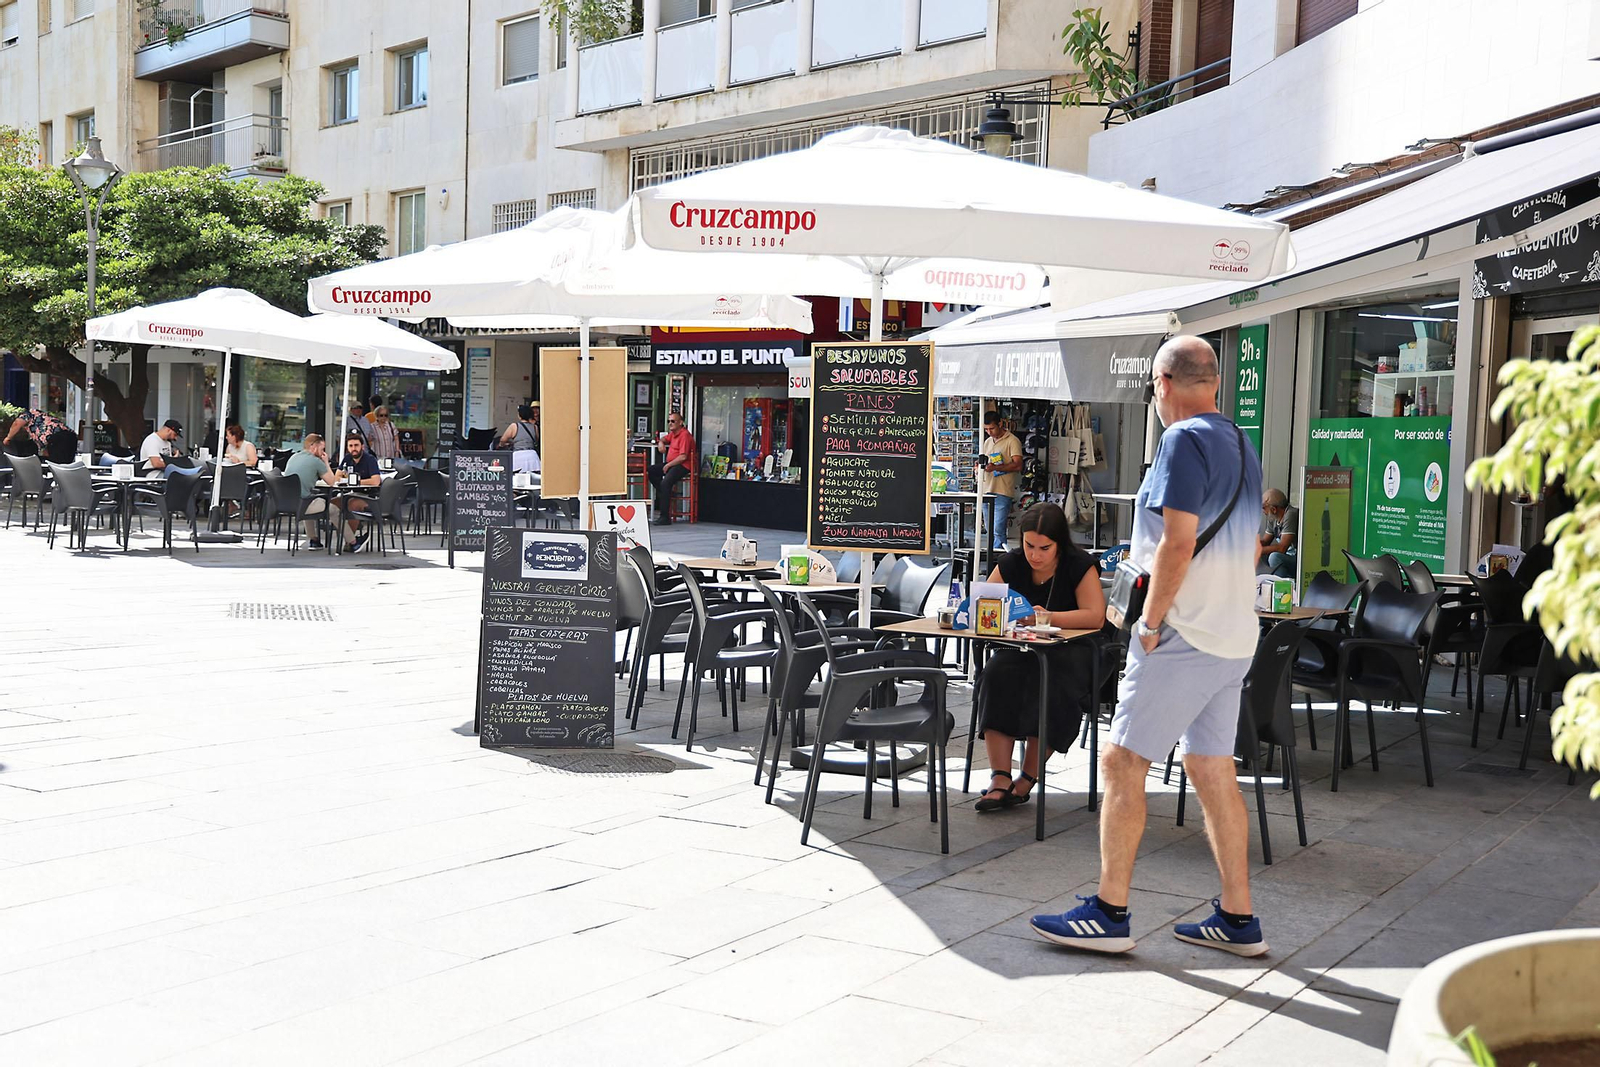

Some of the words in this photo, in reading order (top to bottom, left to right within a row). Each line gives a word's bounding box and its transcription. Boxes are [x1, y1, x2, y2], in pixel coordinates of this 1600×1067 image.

[669, 200, 816, 235] Cruzcampo
[1533, 211, 1542, 223] EL
[700, 235, 741, 246] DESDE
[752, 236, 784, 247] 1904
[1209, 264, 1249, 273] reciclado
[1512, 258, 1558, 280] CAFETERÍA
[332, 286, 431, 306] Cruzcampo
[148, 323, 204, 338] Cruzcampo
[856, 321, 898, 332] ESCO
[1241, 337, 1254, 362] 9h
[1255, 348, 1260, 360] a
[655, 349, 717, 365] ESTANCO
[720, 349, 739, 365] EL
[741, 349, 793, 365] PUNT
[826, 348, 907, 365] DESAYUNOS
[994, 353, 1003, 387] EL
[1109, 352, 1151, 377] Cruzcampo
[830, 369, 918, 386] SALUDABLES
[1239, 367, 1259, 392] 22h
[1240, 408, 1256, 419] domingo
[829, 413, 878, 425] SEMILLA
[885, 414, 925, 426] CHAPATA
[829, 425, 877, 437] INTEGRAL
[1311, 428, 1330, 439] Calidad
[1330, 431, 1334, 441] y
[1334, 428, 1364, 439] naturalidad
[1394, 429, 1405, 440] Por
[1406, 431, 1416, 440] ser
[1417, 428, 1434, 440] socio
[1434, 429, 1444, 440] de
[825, 437, 851, 451] PARA
[856, 437, 917, 453] ACOMPAÑAR
[826, 457, 870, 468] AGUACATE
[458, 470, 500, 481] OFERTON
[825, 468, 856, 478] TOMATE
[858, 468, 896, 479] NATURAL
[824, 478, 877, 488] SALMOREJO
[1313, 474, 1333, 485] unidad
[455, 482, 494, 491] PELOTAZOS
[456, 492, 490, 501] GAMBAS
[823, 488, 847, 496] QUESO
[851, 489, 879, 498] FRESCO
[824, 497, 877, 508] MANTEQUILLA
[456, 508, 480, 516] JAMON
[607, 505, 617, 525] I
[824, 505, 853, 515] ACEITE
[825, 513, 847, 523] MIEL
[823, 525, 848, 537] ZUMO
[851, 526, 888, 538] NARANJA
[892, 527, 923, 539] NATURAL
[454, 535, 485, 546] Cruzca
[491, 580, 530, 592] NUESTRA
[536, 582, 576, 596] CERVEZA
[490, 598, 513, 606] VINOS
[515, 598, 531, 606] DEL
[535, 600, 576, 609] CONDADO
[582, 609, 611, 618] HUELVA
[538, 615, 570, 624] HUELVA
[509, 628, 536, 638] TAPAS
[540, 630, 589, 641] CASERAS
[490, 679, 528, 688] CARACOLES
[507, 693, 539, 702] PLATOS
[541, 694, 552, 702] DE
[556, 693, 589, 702] HUELVA
[489, 709, 513, 717] PLATO
